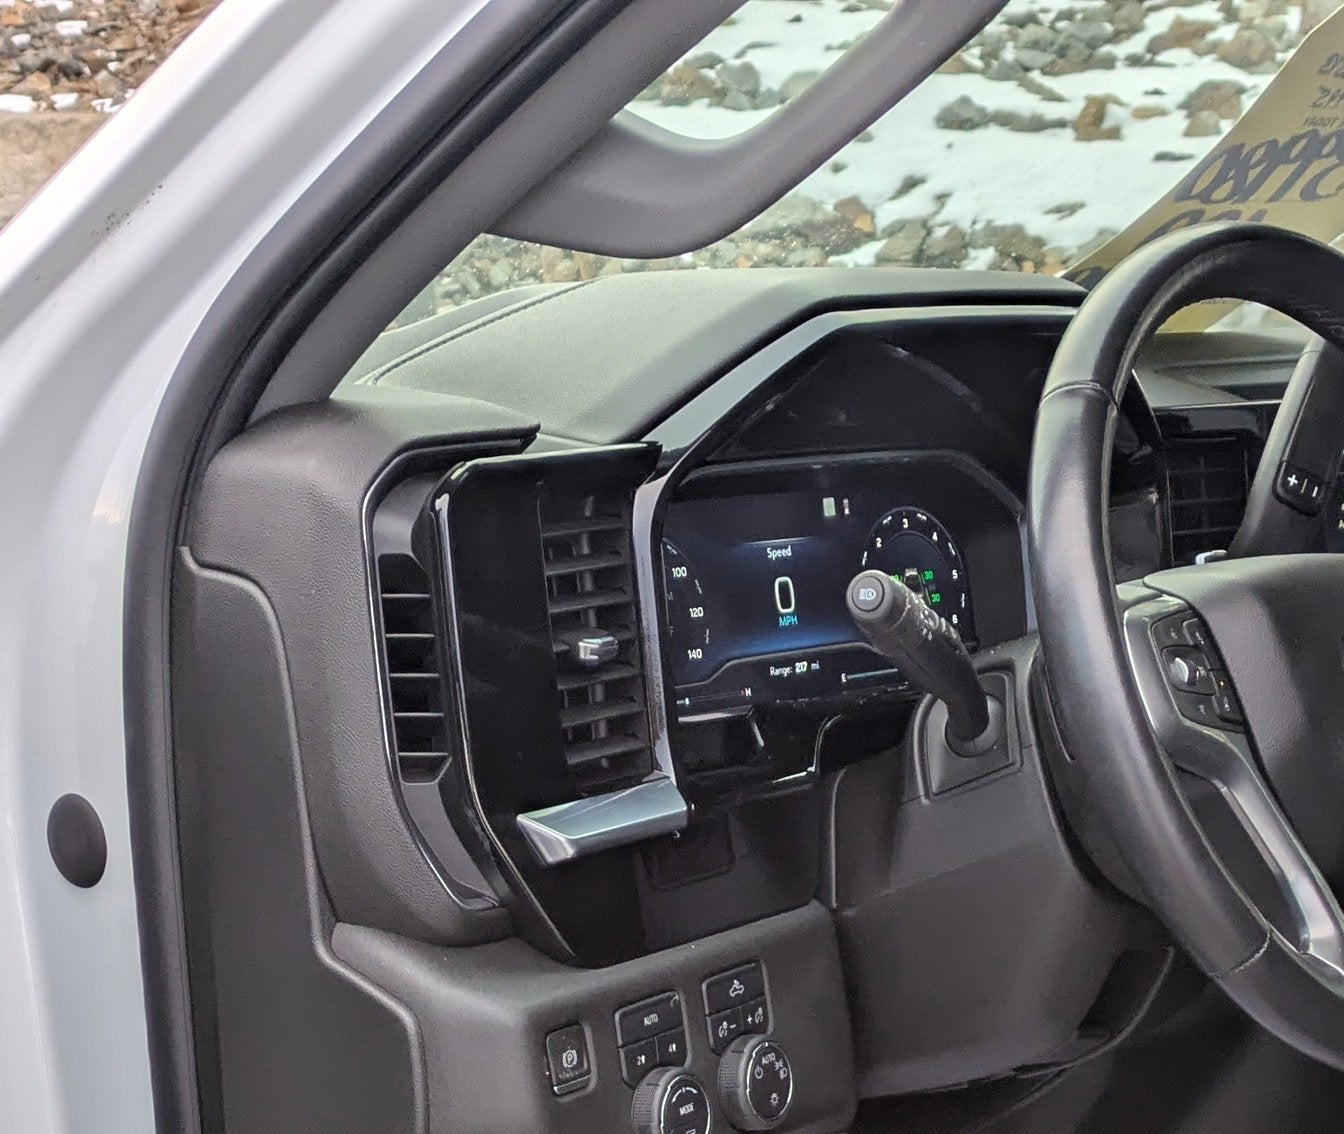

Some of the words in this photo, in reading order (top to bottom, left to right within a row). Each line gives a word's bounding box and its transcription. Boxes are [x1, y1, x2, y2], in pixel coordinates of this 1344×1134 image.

[903, 518, 909, 529] 3
[876, 537, 882, 548] 2
[932, 531, 938, 542] 4
[766, 545, 792, 560] Speed
[671, 566, 687, 578] 100
[952, 569, 958, 579] 5
[774, 576, 795, 613] 0
[689, 606, 704, 618] 120
[778, 615, 798, 627] MPH
[952, 614, 958, 624] 6
[687, 648, 703, 660] 140
[770, 664, 793, 677] Range:
[745, 687, 752, 697] H
[644, 1013, 659, 1026] AUTO
[679, 1102, 695, 1116] MODE
